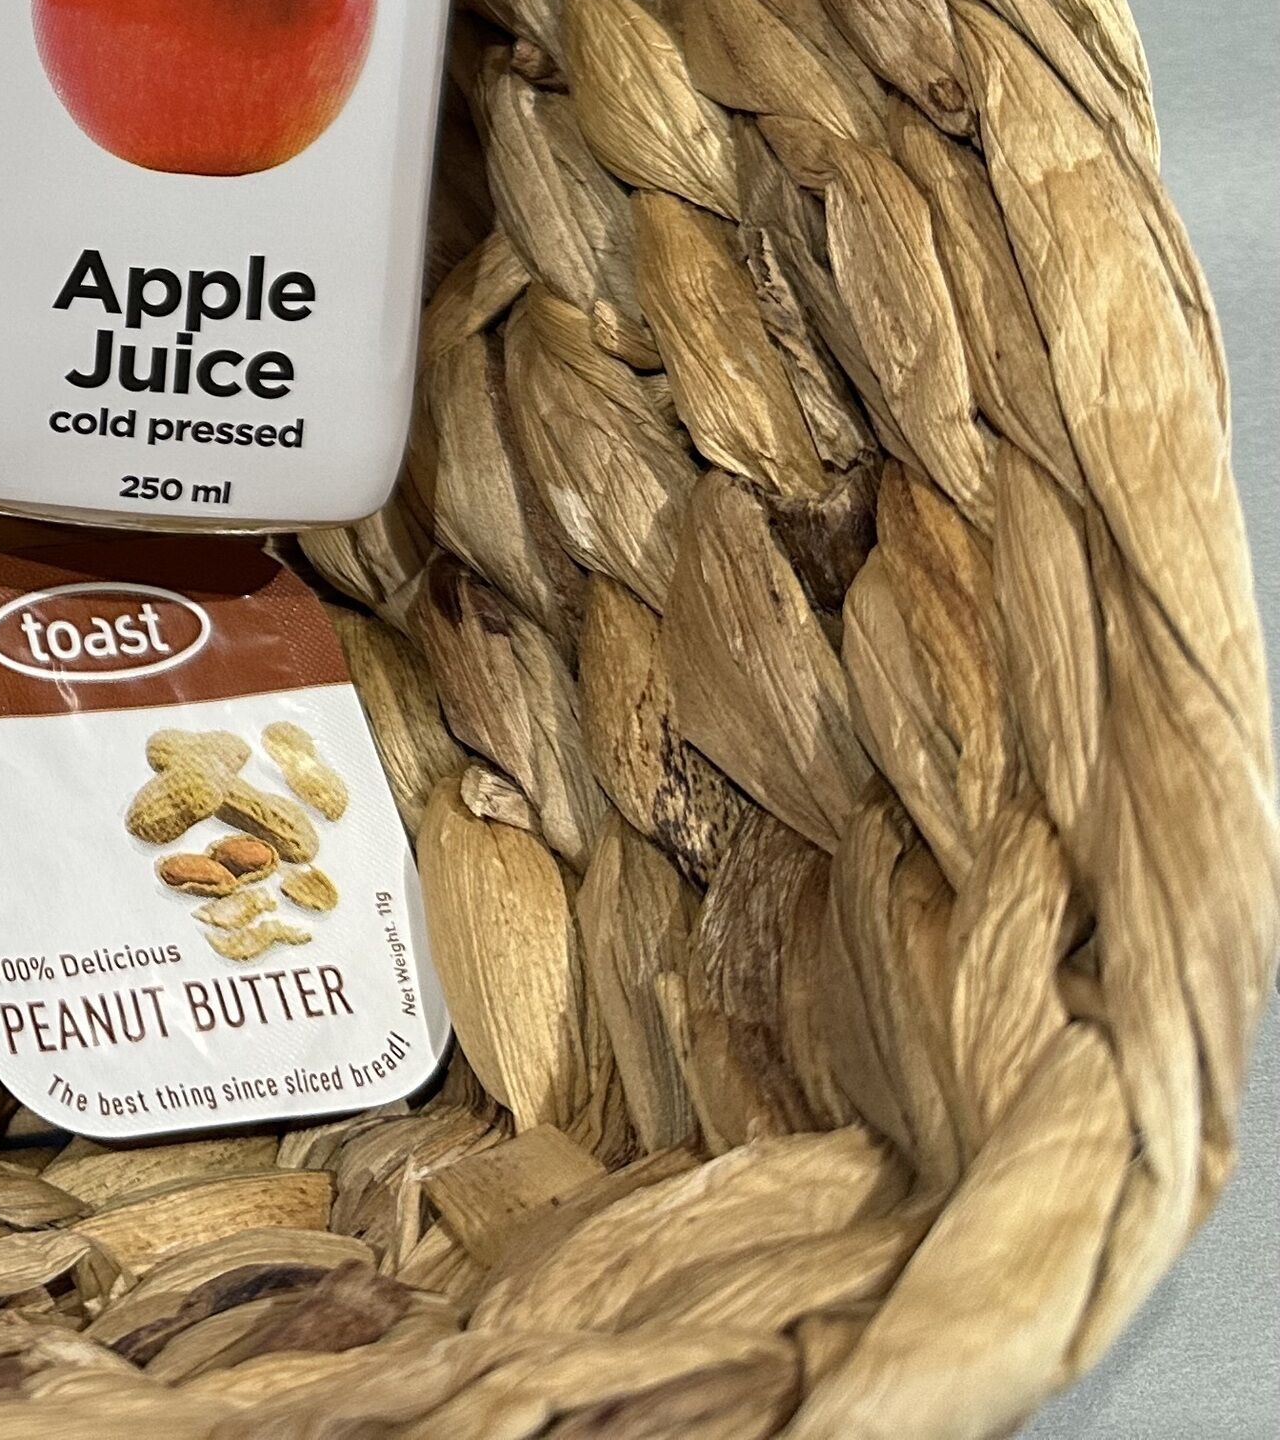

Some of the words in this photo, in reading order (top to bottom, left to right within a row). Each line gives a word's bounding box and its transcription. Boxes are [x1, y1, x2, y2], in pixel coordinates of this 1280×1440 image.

[52, 249, 316, 332] Apple
[64, 329, 294, 399] Juice
[48, 407, 137, 438] cold
[147, 417, 304, 449] pressed
[119, 475, 183, 501] 250
[191, 481, 231, 504] ml
[21, 603, 171, 663] toast
[375, 892, 392, 916] 11g
[62, 943, 182, 977] Delicious
[184, 965, 354, 1032] BUTTER
[401, 987, 416, 1016] Net
[46, 1074, 88, 1112] The
[99, 1091, 150, 1116] best
[156, 1084, 218, 1110] thing
[222, 1076, 278, 1103] since
[285, 1064, 344, 1094] sliced
[349, 1030, 411, 1087] bread!
